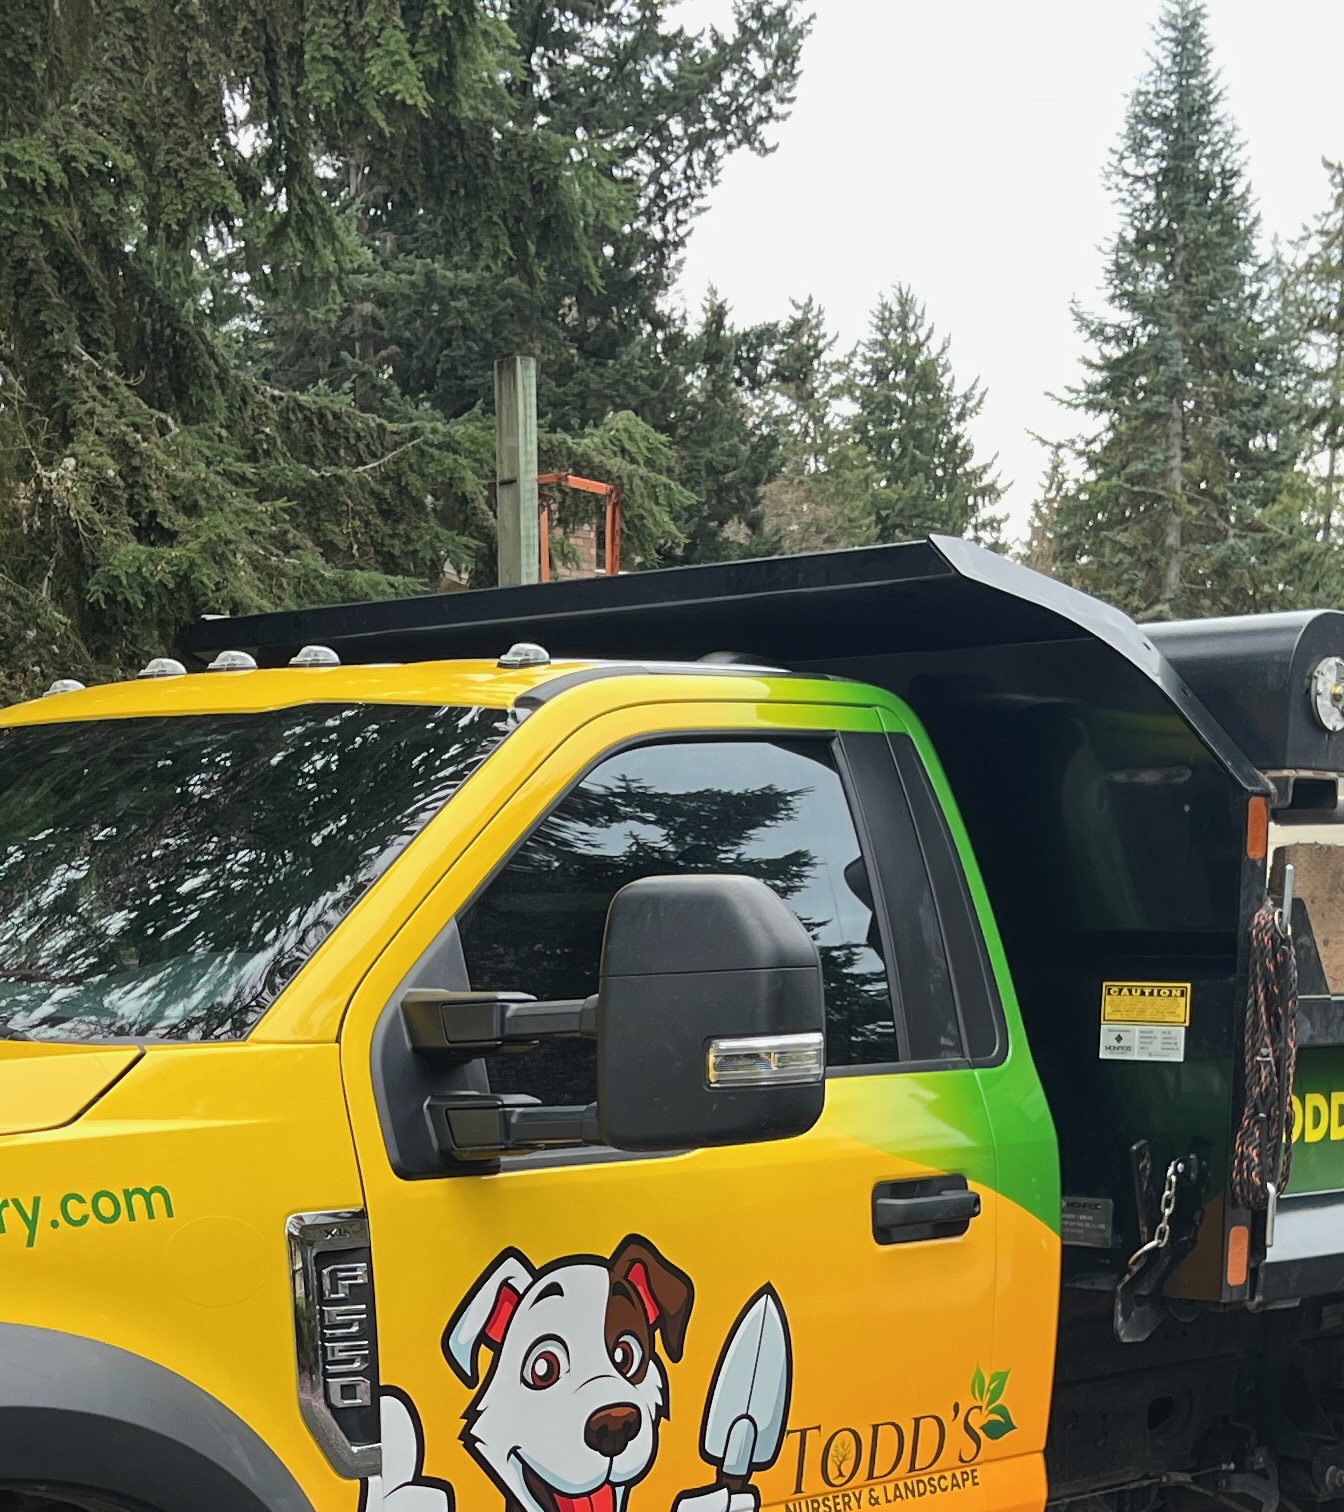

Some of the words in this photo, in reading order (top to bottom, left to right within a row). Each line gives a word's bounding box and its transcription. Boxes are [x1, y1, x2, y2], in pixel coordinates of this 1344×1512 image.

[1108, 987, 1182, 997] CAUTION
[324, 1227, 351, 1240] XL
[321, 1262, 373, 1409] F550
[786, 1401, 984, 1496] TODD'S
[868, 1487, 882, 1507] &
[883, 1468, 980, 1505] LANDSCAPE
